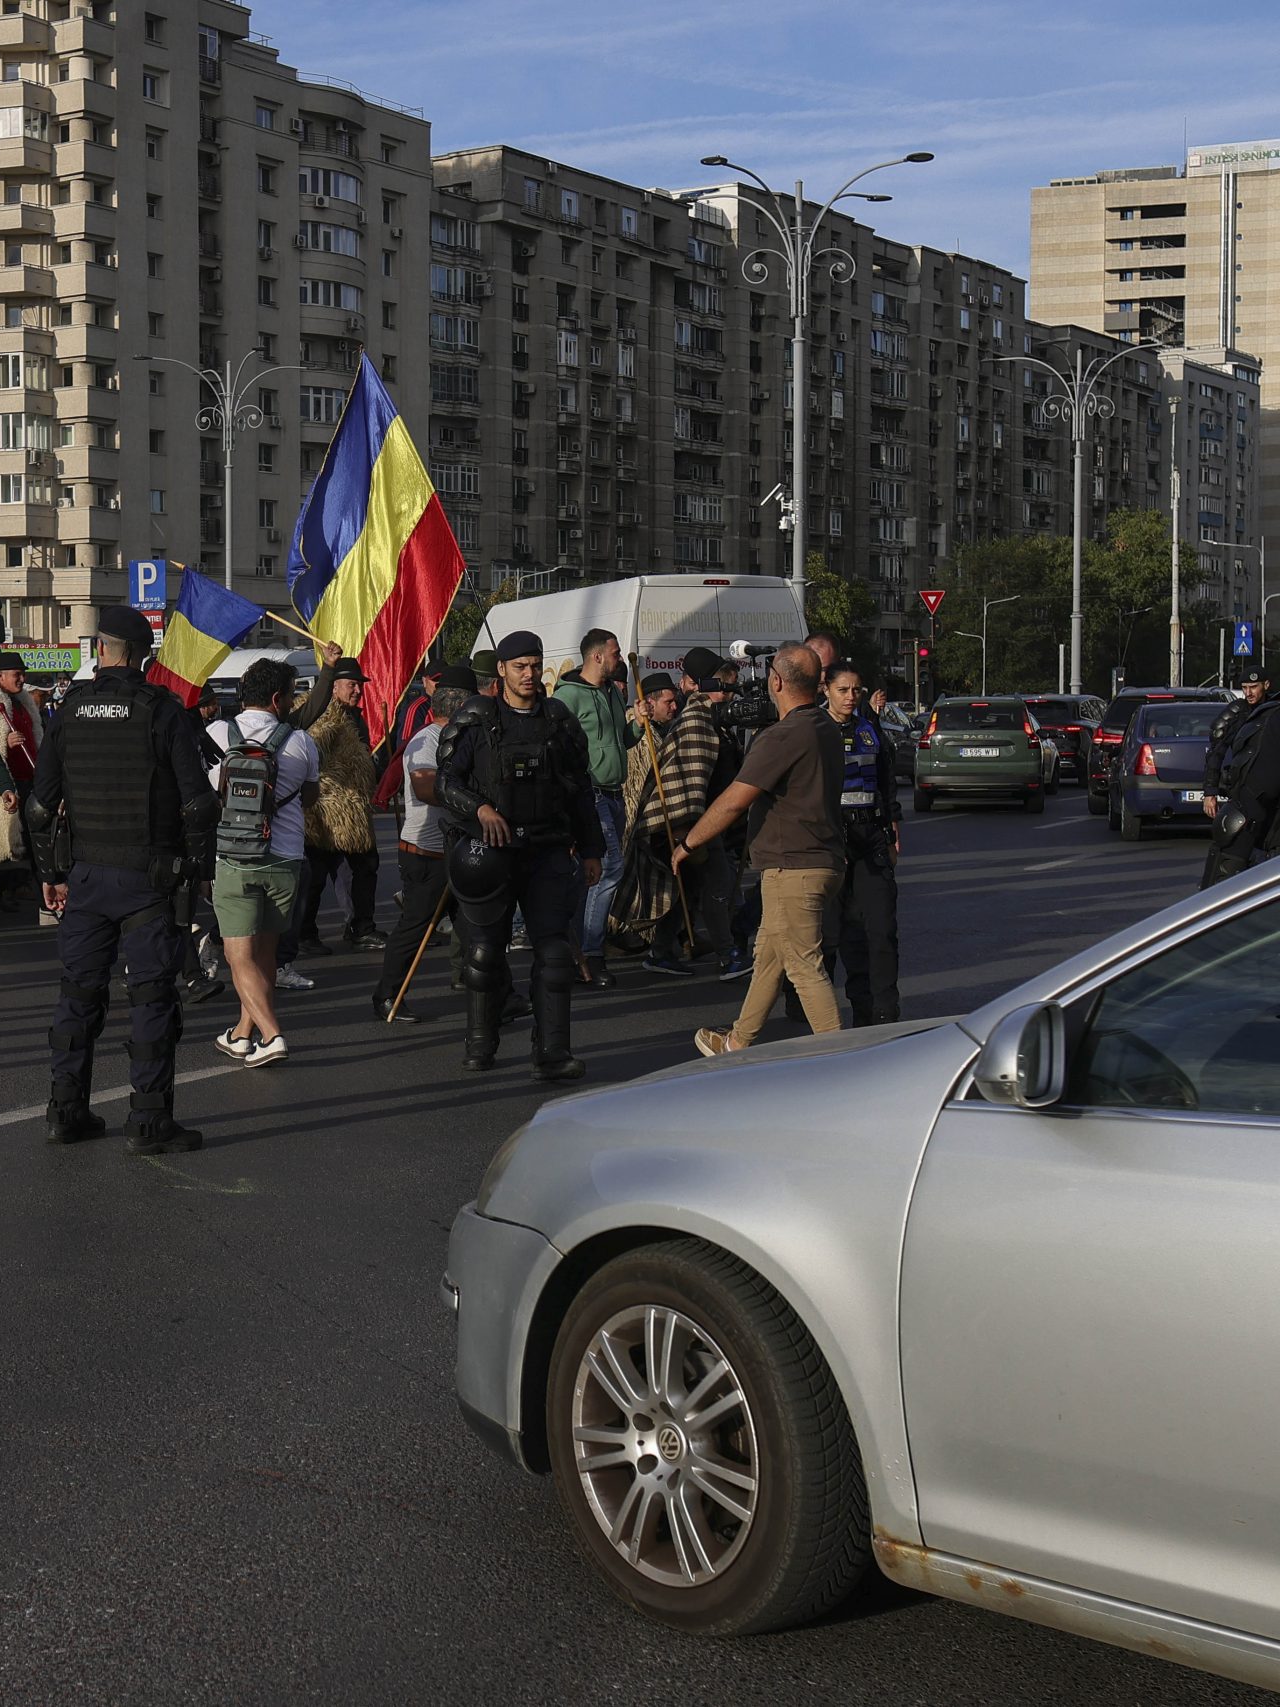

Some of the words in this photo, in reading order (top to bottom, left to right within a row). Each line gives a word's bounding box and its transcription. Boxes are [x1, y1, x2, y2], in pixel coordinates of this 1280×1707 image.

[138, 562, 157, 602] P
[682, 611, 724, 632] PRODUSE
[726, 612, 737, 632] DE
[23, 651, 72, 660] MACIA
[75, 705, 129, 718] JANDARMERIA
[234, 786, 256, 795] LiveU
